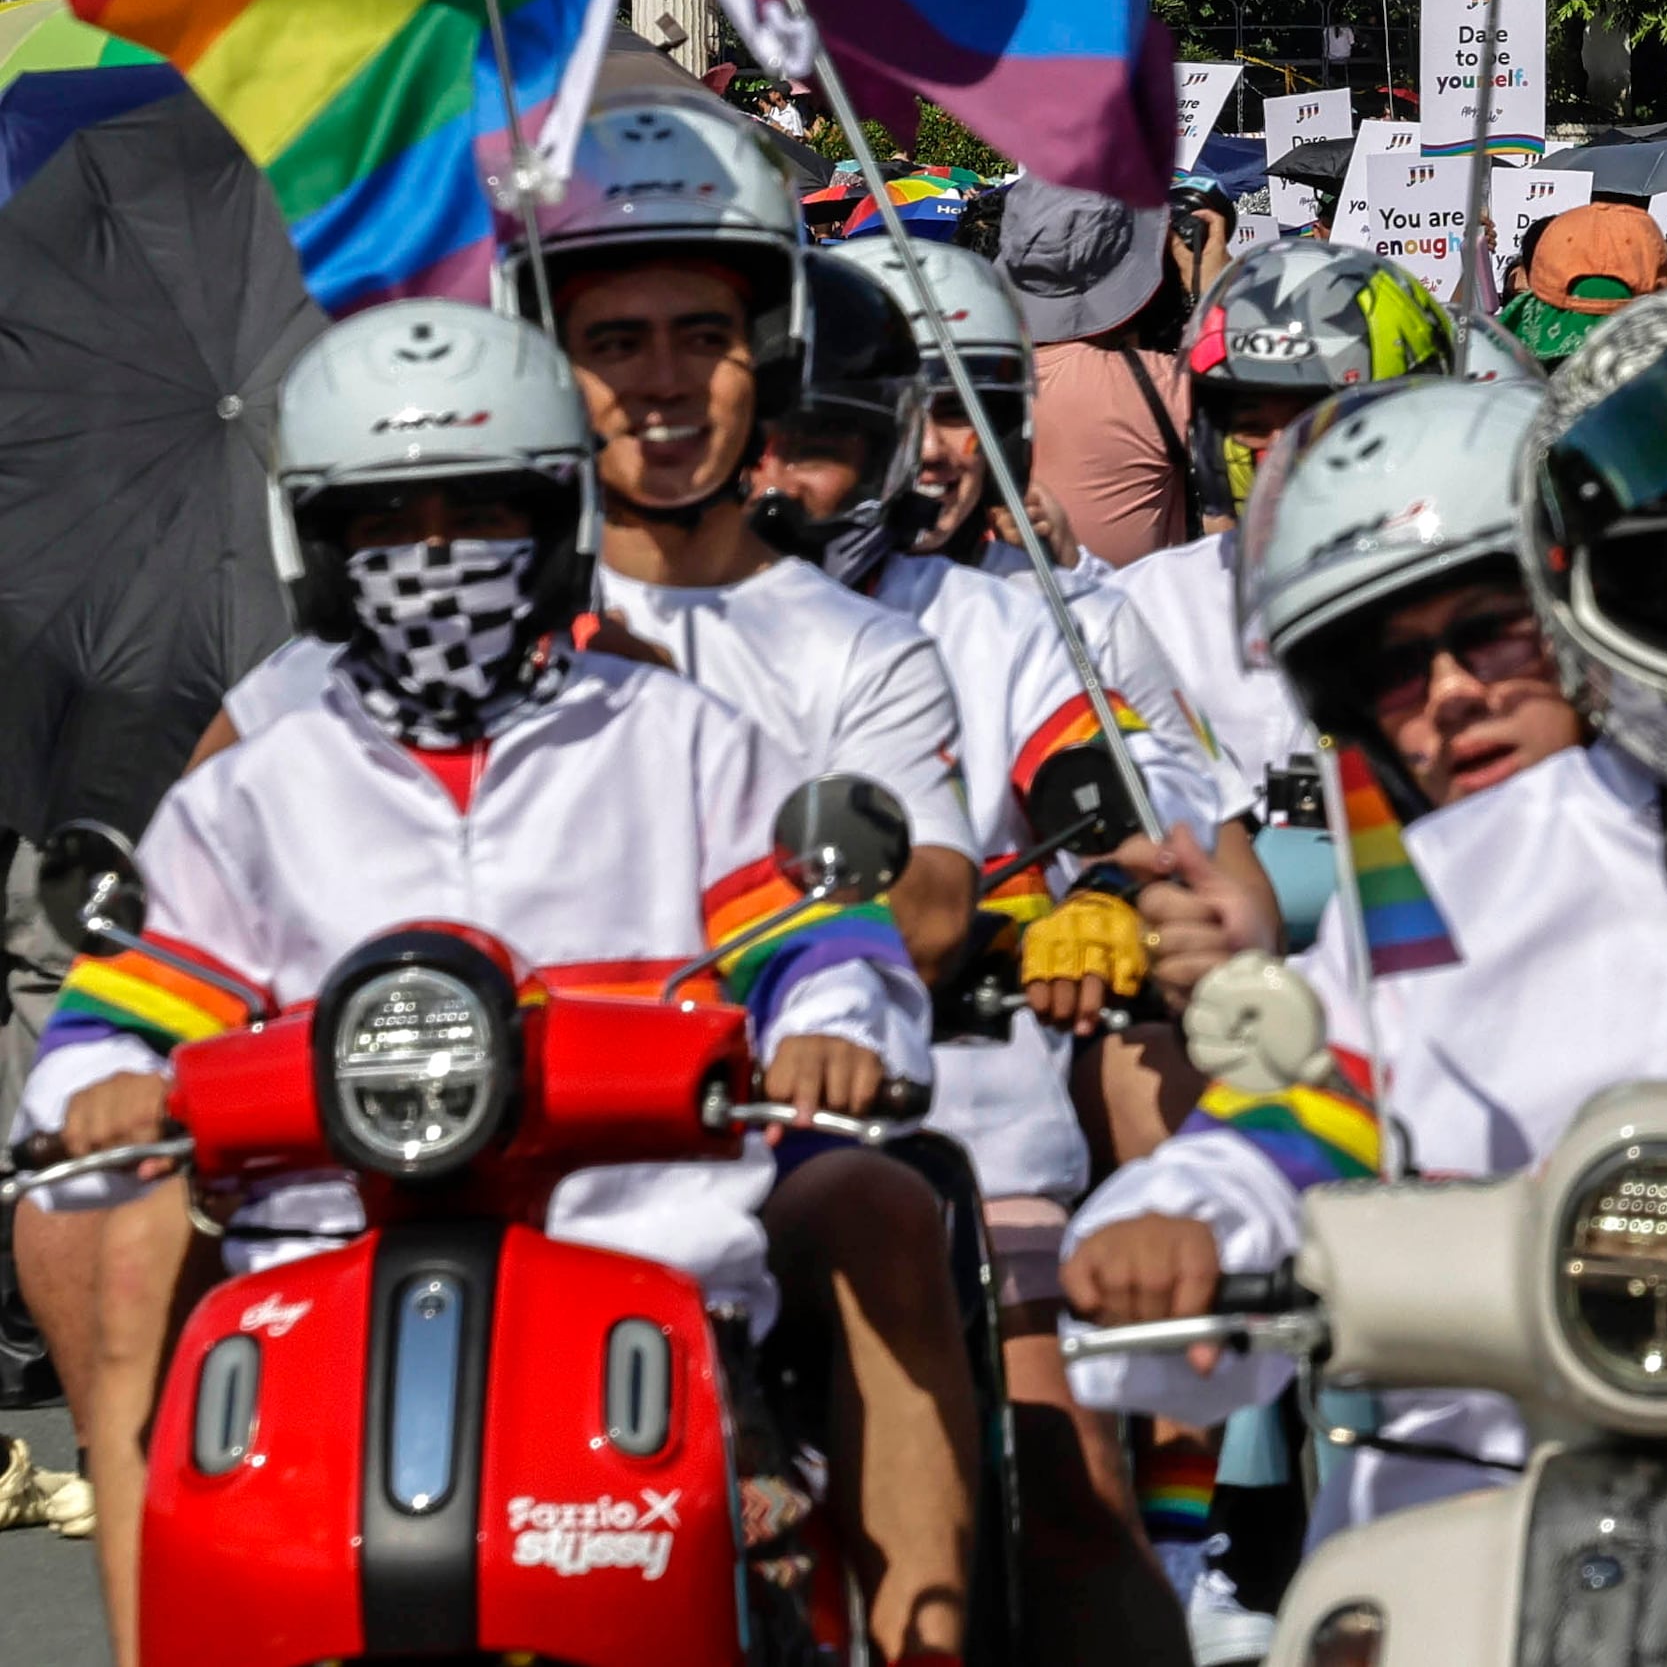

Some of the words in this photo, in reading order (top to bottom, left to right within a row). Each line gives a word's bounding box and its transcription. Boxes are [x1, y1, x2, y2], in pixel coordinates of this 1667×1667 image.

[1459, 25, 1508, 44] Dae
[1455, 49, 1478, 67] to
[1436, 68, 1529, 95] youelf.
[1176, 98, 1200, 109] are
[1379, 207, 1421, 230] You
[1429, 210, 1464, 228] are
[1376, 231, 1463, 259] enough
